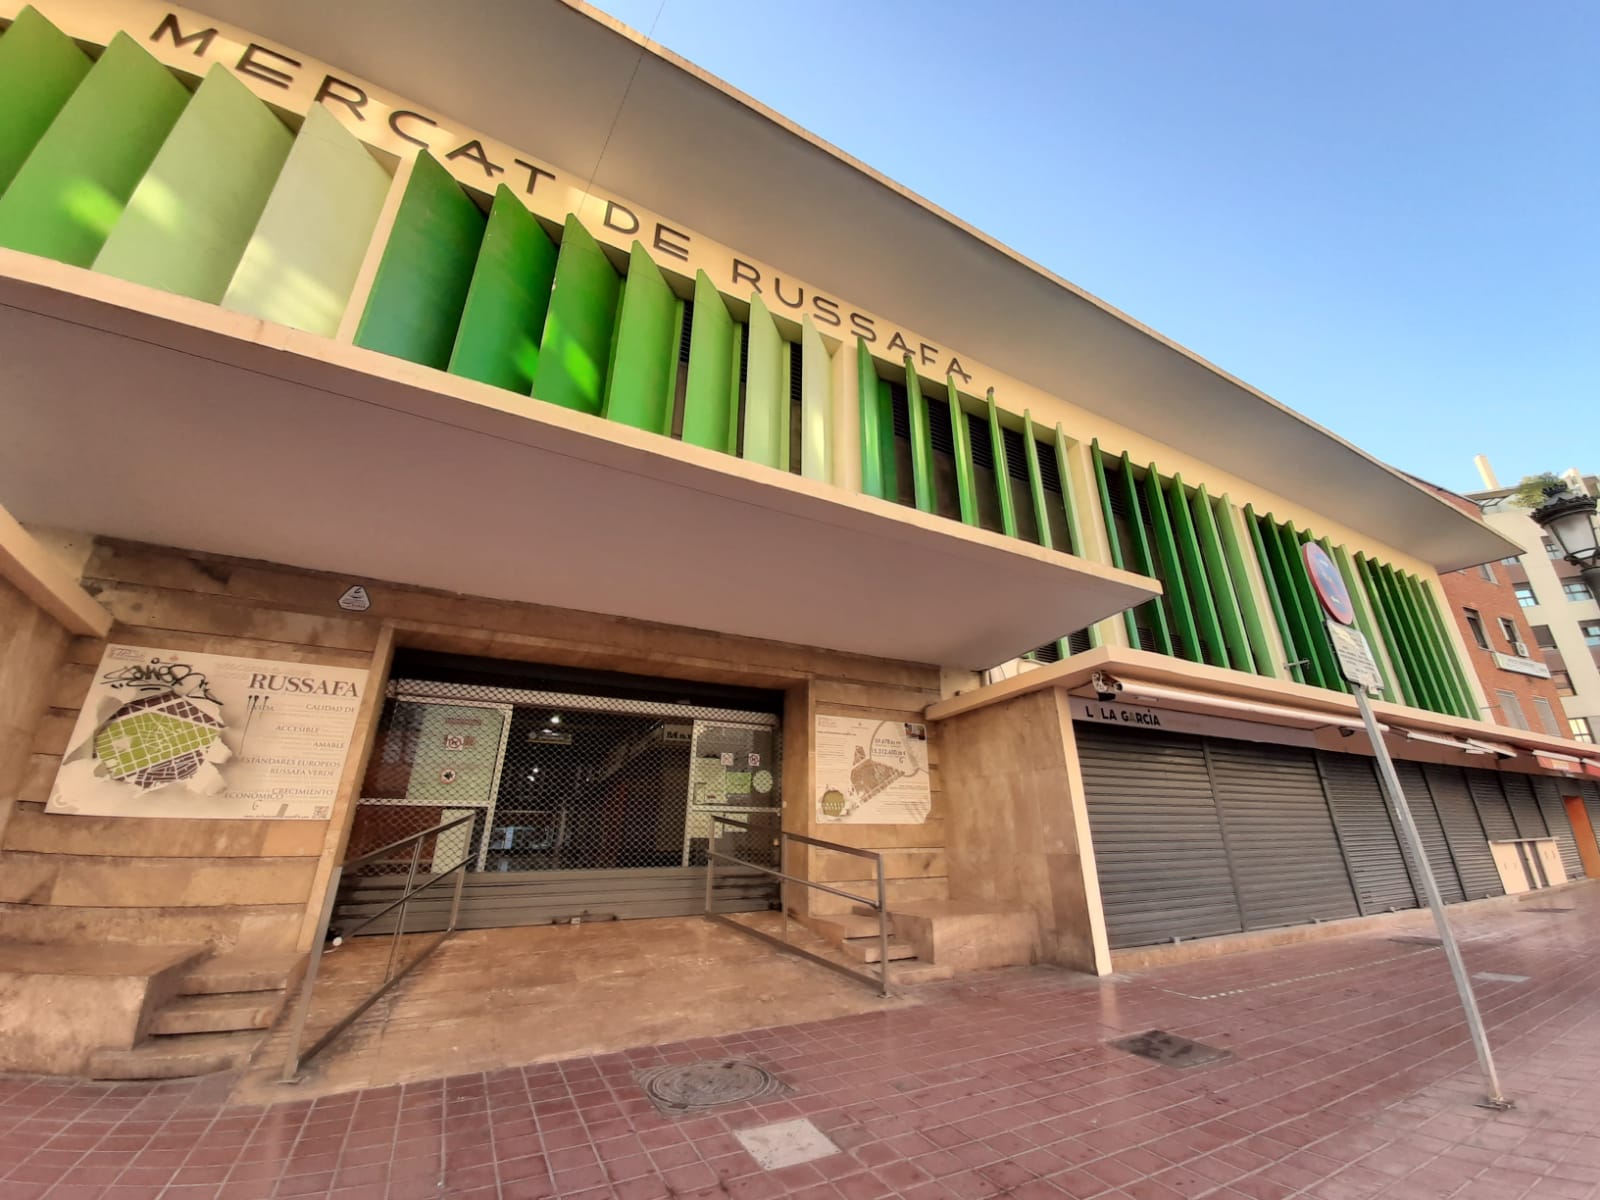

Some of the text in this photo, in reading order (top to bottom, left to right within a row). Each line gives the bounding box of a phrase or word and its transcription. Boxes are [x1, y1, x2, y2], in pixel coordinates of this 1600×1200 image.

[150, 13, 973, 385] MERCAT DE RUSSAFA
[248, 673, 359, 697] RUSSAFA
[305, 703, 343, 713] CALIDAD
[1085, 705, 1161, 726] LLA GRCÍA
[313, 741, 345, 749] AMABLE
[297, 759, 341, 768] EUROPEOS
[270, 767, 306, 776] RUSSAFA
[271, 787, 334, 796] CRECIMIENTO
